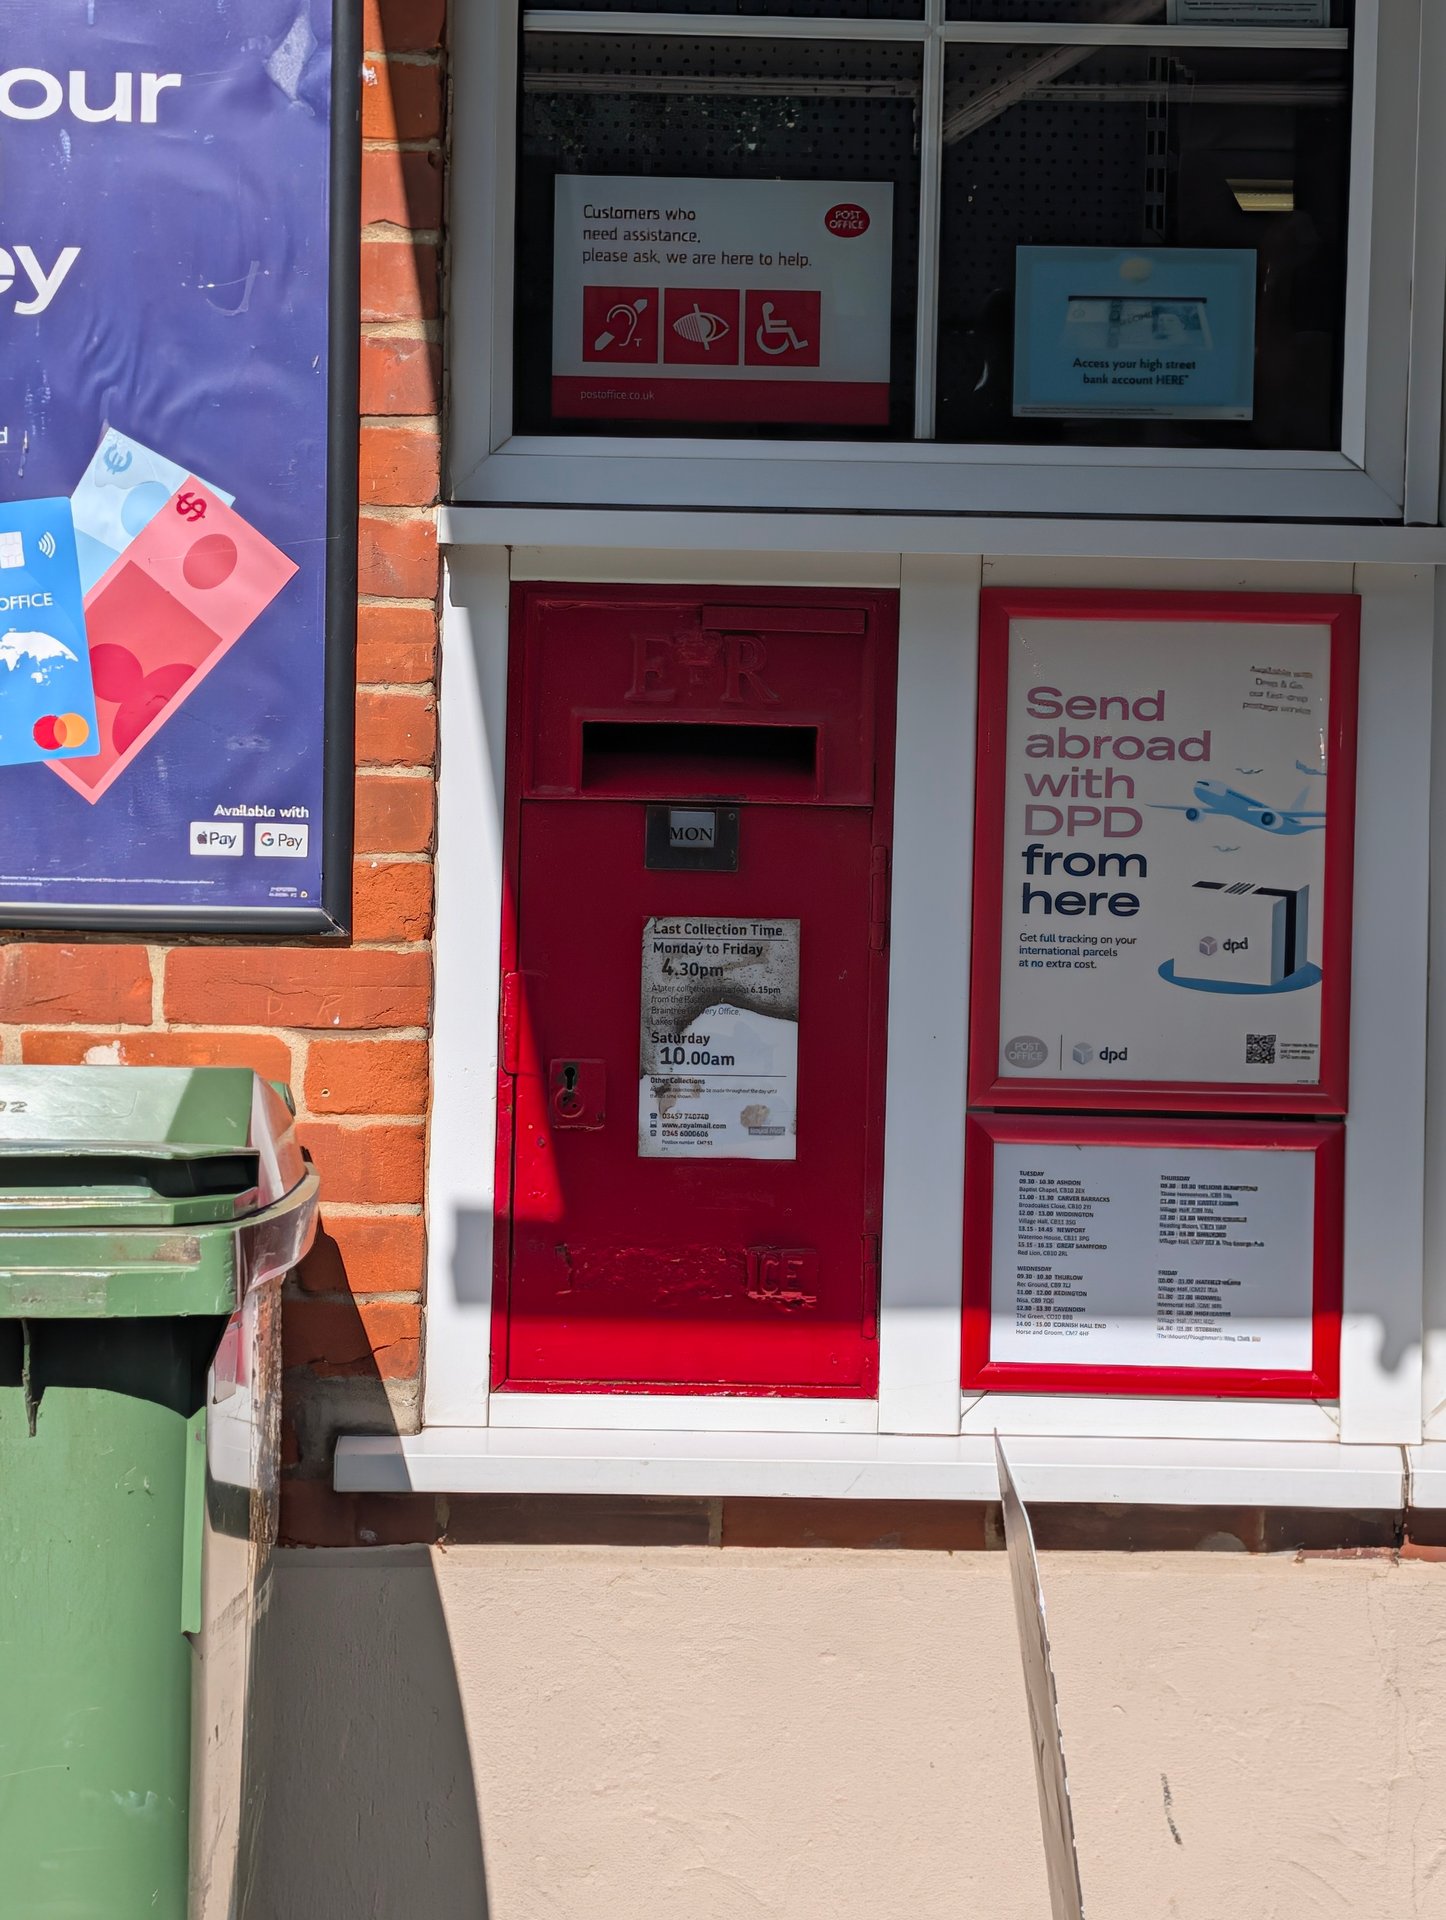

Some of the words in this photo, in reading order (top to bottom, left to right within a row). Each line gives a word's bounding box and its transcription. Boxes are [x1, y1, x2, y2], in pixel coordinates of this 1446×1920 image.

[583, 204, 660, 221] Customers
[665, 207, 696, 222] who
[835, 210, 861, 220] POST
[829, 220, 864, 231] OFFICE
[583, 227, 618, 242] need
[582, 250, 628, 265] please
[666, 254, 687, 265] we
[692, 253, 717, 266] are
[721, 252, 754, 266] here
[759, 253, 773, 266] to
[778, 253, 813, 270] help.
[0, 245, 81, 315] y
[1072, 358, 1110, 370] Access
[1112, 360, 1137, 372] your
[1139, 358, 1163, 372] high
[1165, 361, 1196, 371] street
[1082, 374, 1109, 385] bank
[1111, 375, 1154, 386] account
[580, 390, 655, 402] postoffice.co.uk
[0, 592, 54, 612] OFFICE
[1026, 686, 1165, 722] Send
[1024, 727, 1211, 762] abroad
[1024, 766, 1135, 799] with
[214, 804, 276, 818] Available
[279, 806, 310, 819] with
[1024, 804, 1143, 838] DPD
[210, 832, 237, 849] Pay
[669, 826, 714, 842] MON
[278, 833, 303, 851] Pay
[1021, 844, 1147, 878] from
[1021, 882, 1140, 916] here
[653, 924, 682, 935] Last
[684, 923, 748, 936] Collection
[1019, 933, 1037, 944] Get
[1039, 933, 1056, 944] full
[1058, 934, 1098, 947] tracking
[1100, 937, 1113, 945] on
[1115, 937, 1137, 947] your
[1222, 937, 1249, 953] dpd
[653, 942, 704, 955] Monday
[706, 943, 720, 954] to
[723, 943, 764, 958] Friday
[1019, 946, 1080, 957] international
[1082, 947, 1118, 959] parcels
[661, 958, 724, 979] 4.30pm
[1019, 960, 1029, 968] at
[1046, 960, 1073, 969] extra
[1074, 961, 1097, 970] cost.
[750, 987, 781, 995] 6.15pm
[651, 1032, 711, 1047] Saturday
[1014, 1042, 1041, 1051] POST
[659, 1046, 736, 1067] 10.00am
[1008, 1051, 1044, 1061] OFFICE
[1099, 1047, 1128, 1063] dpd
[670, 1077, 706, 1085] Collections
[662, 1122, 727, 1130] www.royalmail.com
[680, 1130, 709, 1138] 6000606
